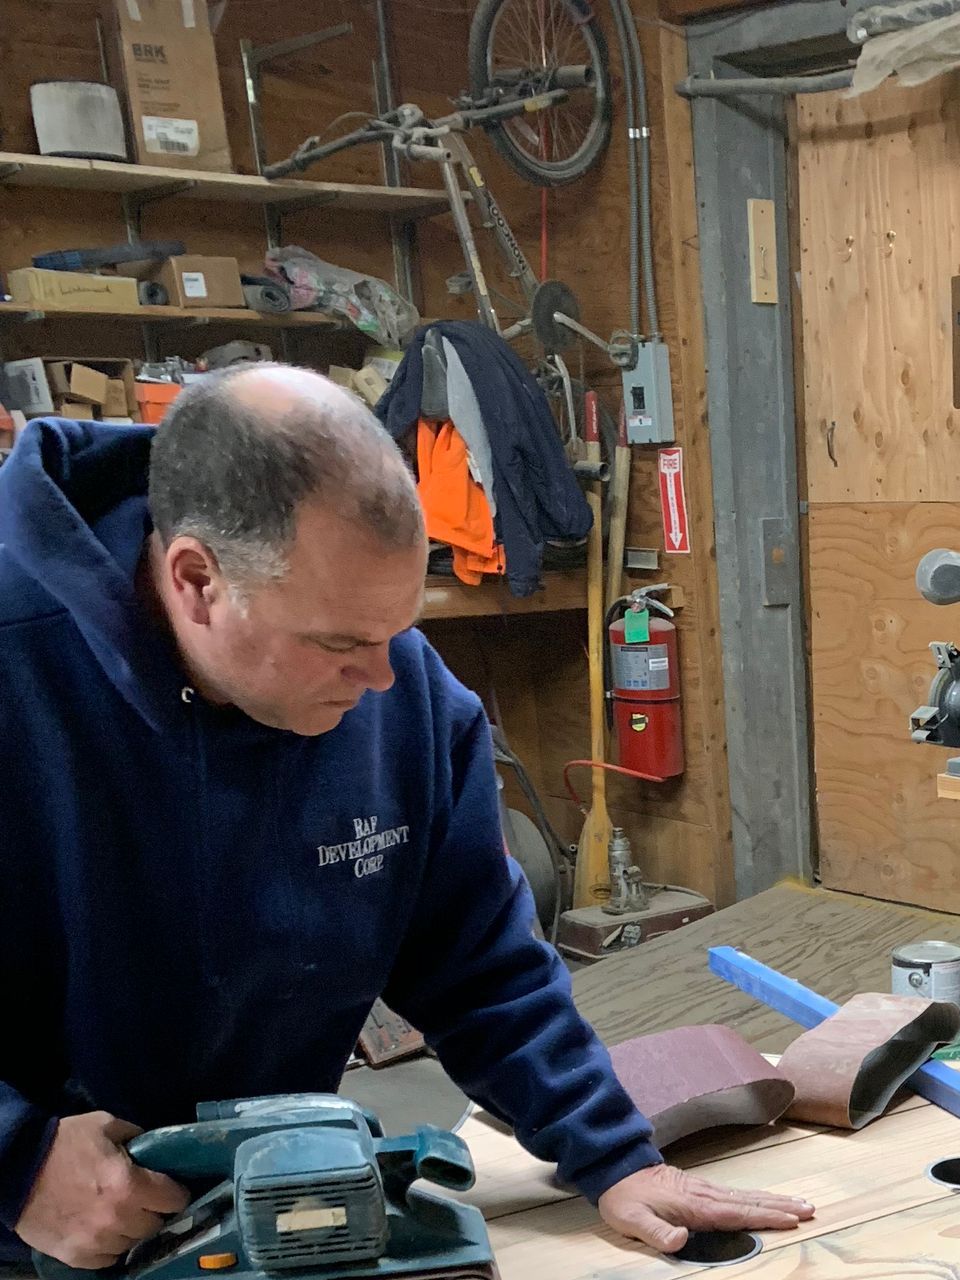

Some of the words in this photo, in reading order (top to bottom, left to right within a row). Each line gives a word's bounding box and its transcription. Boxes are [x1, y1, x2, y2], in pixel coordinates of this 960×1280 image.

[132, 43, 167, 58] BRK
[662, 458, 678, 470] FIRE
[317, 825, 410, 867] DEVELOPMENT
